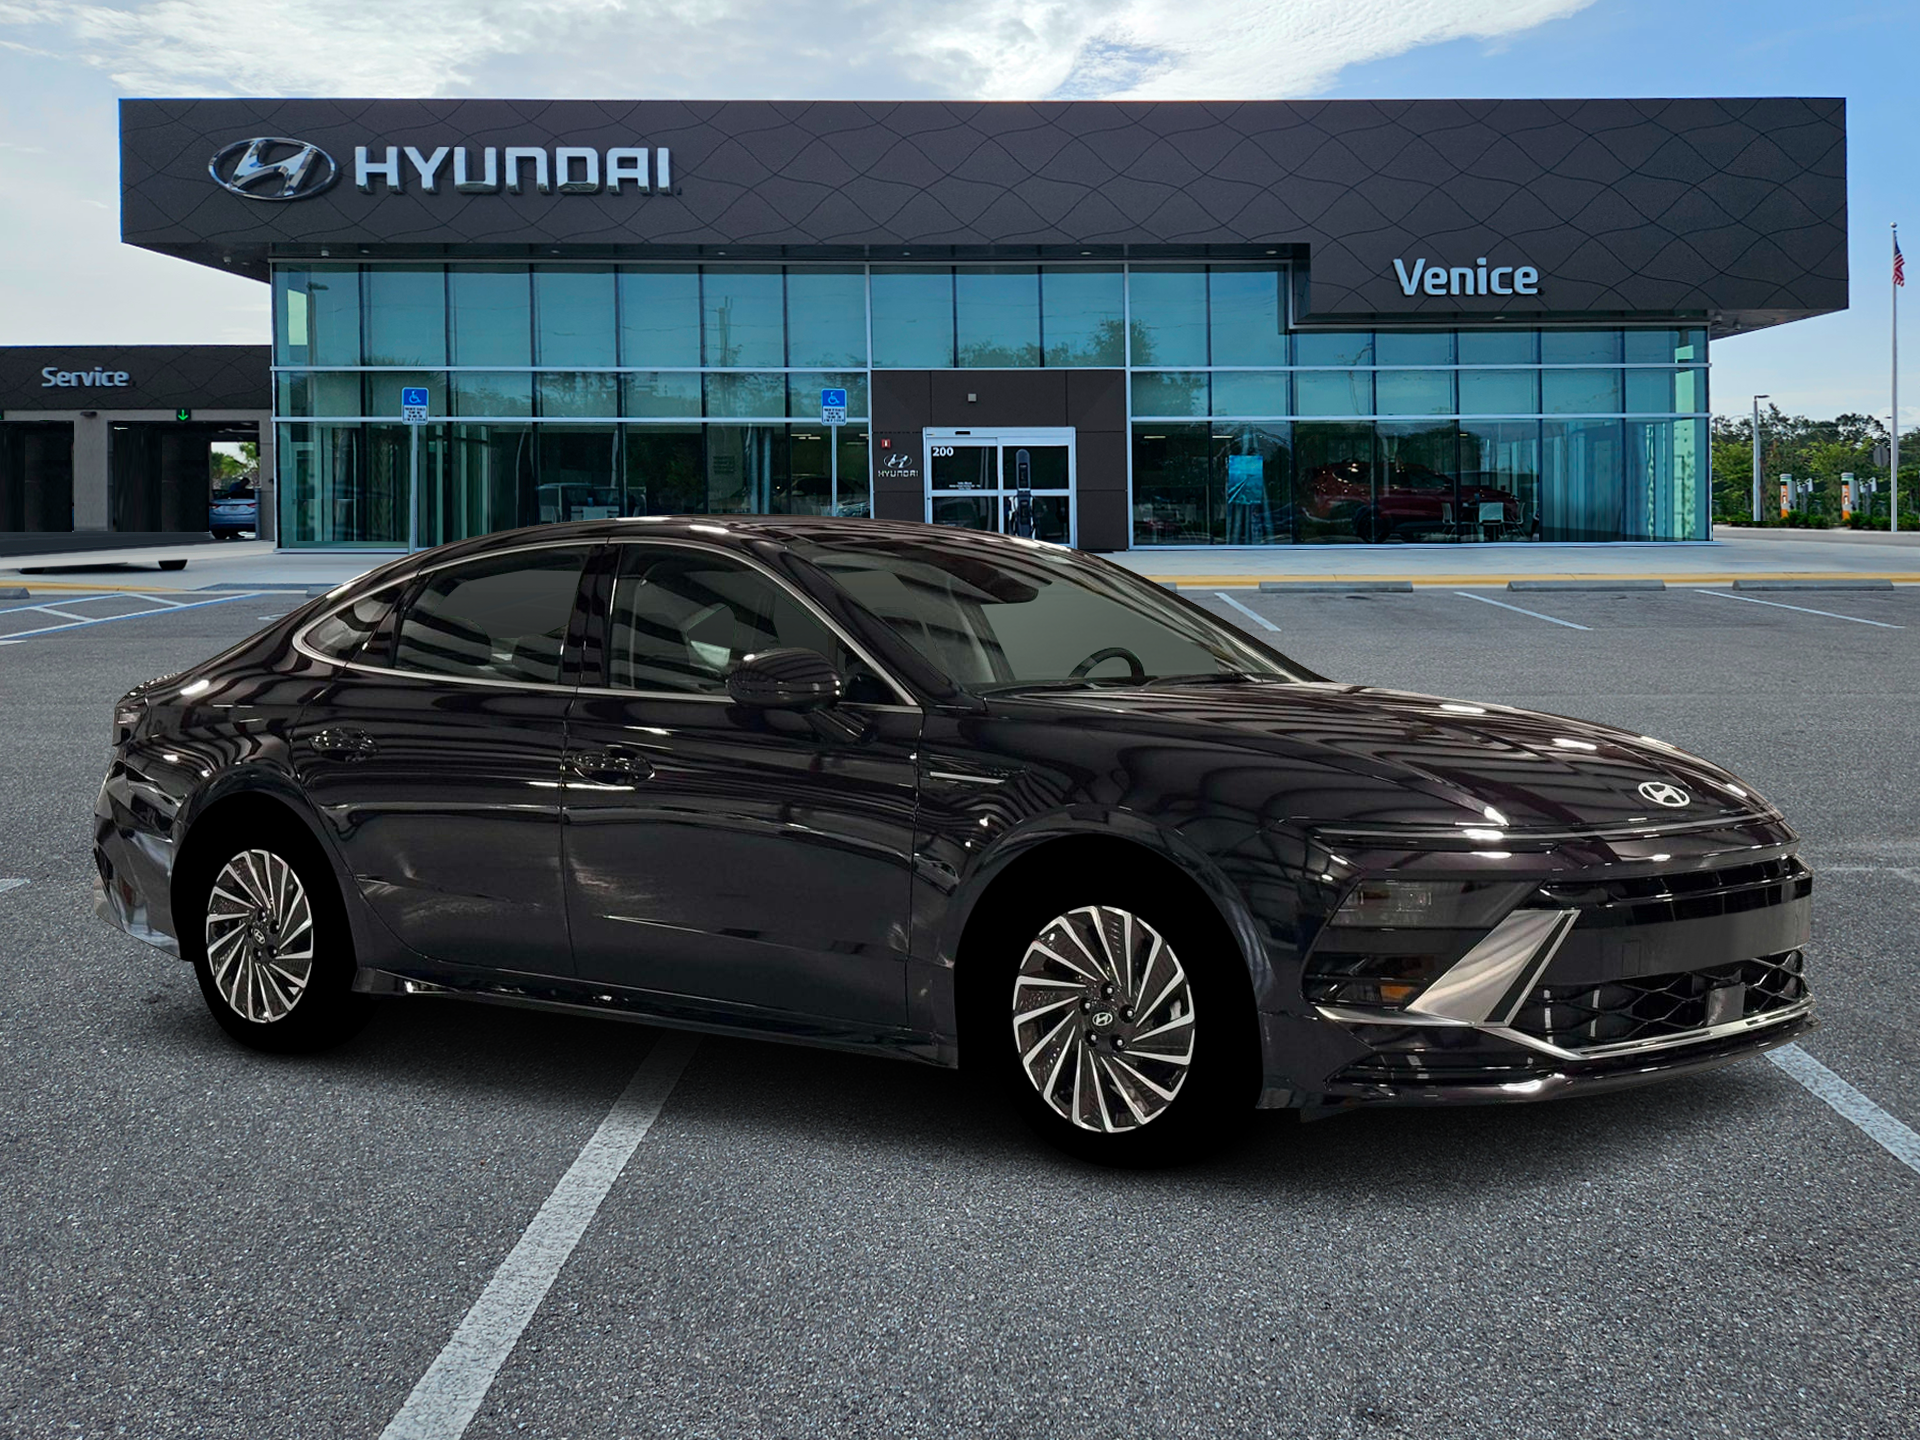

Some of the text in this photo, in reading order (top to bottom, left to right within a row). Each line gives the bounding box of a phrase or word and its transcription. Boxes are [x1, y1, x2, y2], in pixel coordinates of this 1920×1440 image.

[355, 146, 670, 194] HYUNDAI
[1393, 257, 1538, 295] Venice
[41, 366, 130, 387] Service
[932, 446, 954, 457] 200
[877, 469, 919, 478] HYUNDAI
